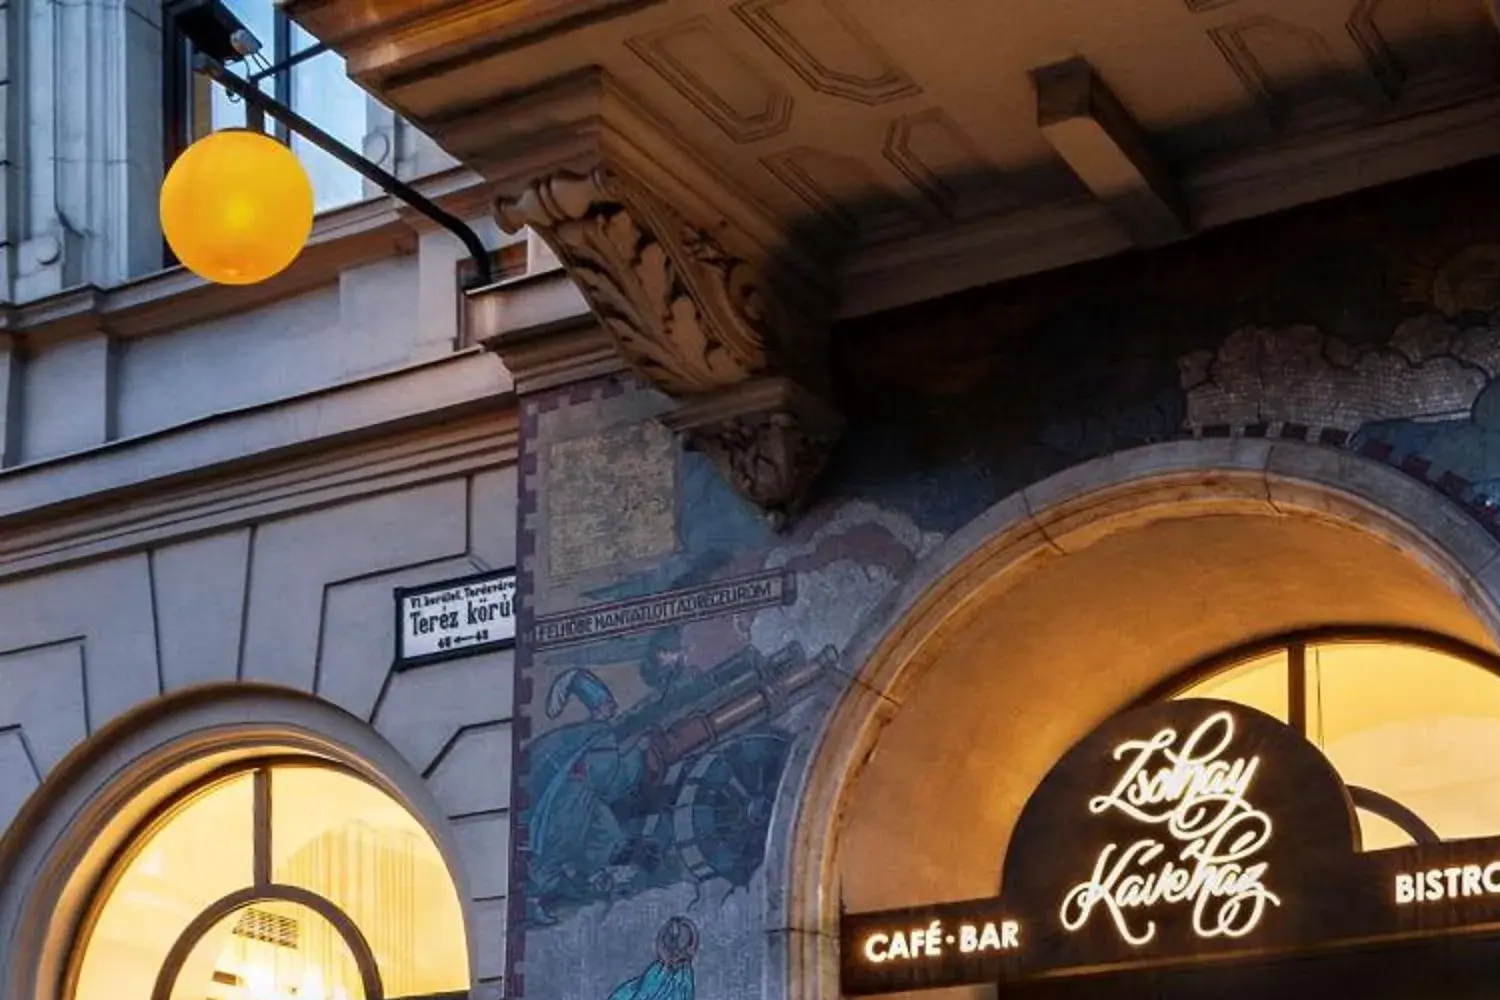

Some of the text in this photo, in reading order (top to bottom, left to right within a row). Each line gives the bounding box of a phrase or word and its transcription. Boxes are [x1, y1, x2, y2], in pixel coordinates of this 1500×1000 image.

[409, 605, 459, 637] Teréz
[1089, 711, 1260, 840] Zsolnay
[1060, 811, 1281, 945] Kávéház
[865, 919, 1019, 963] CAFÉ BAR
